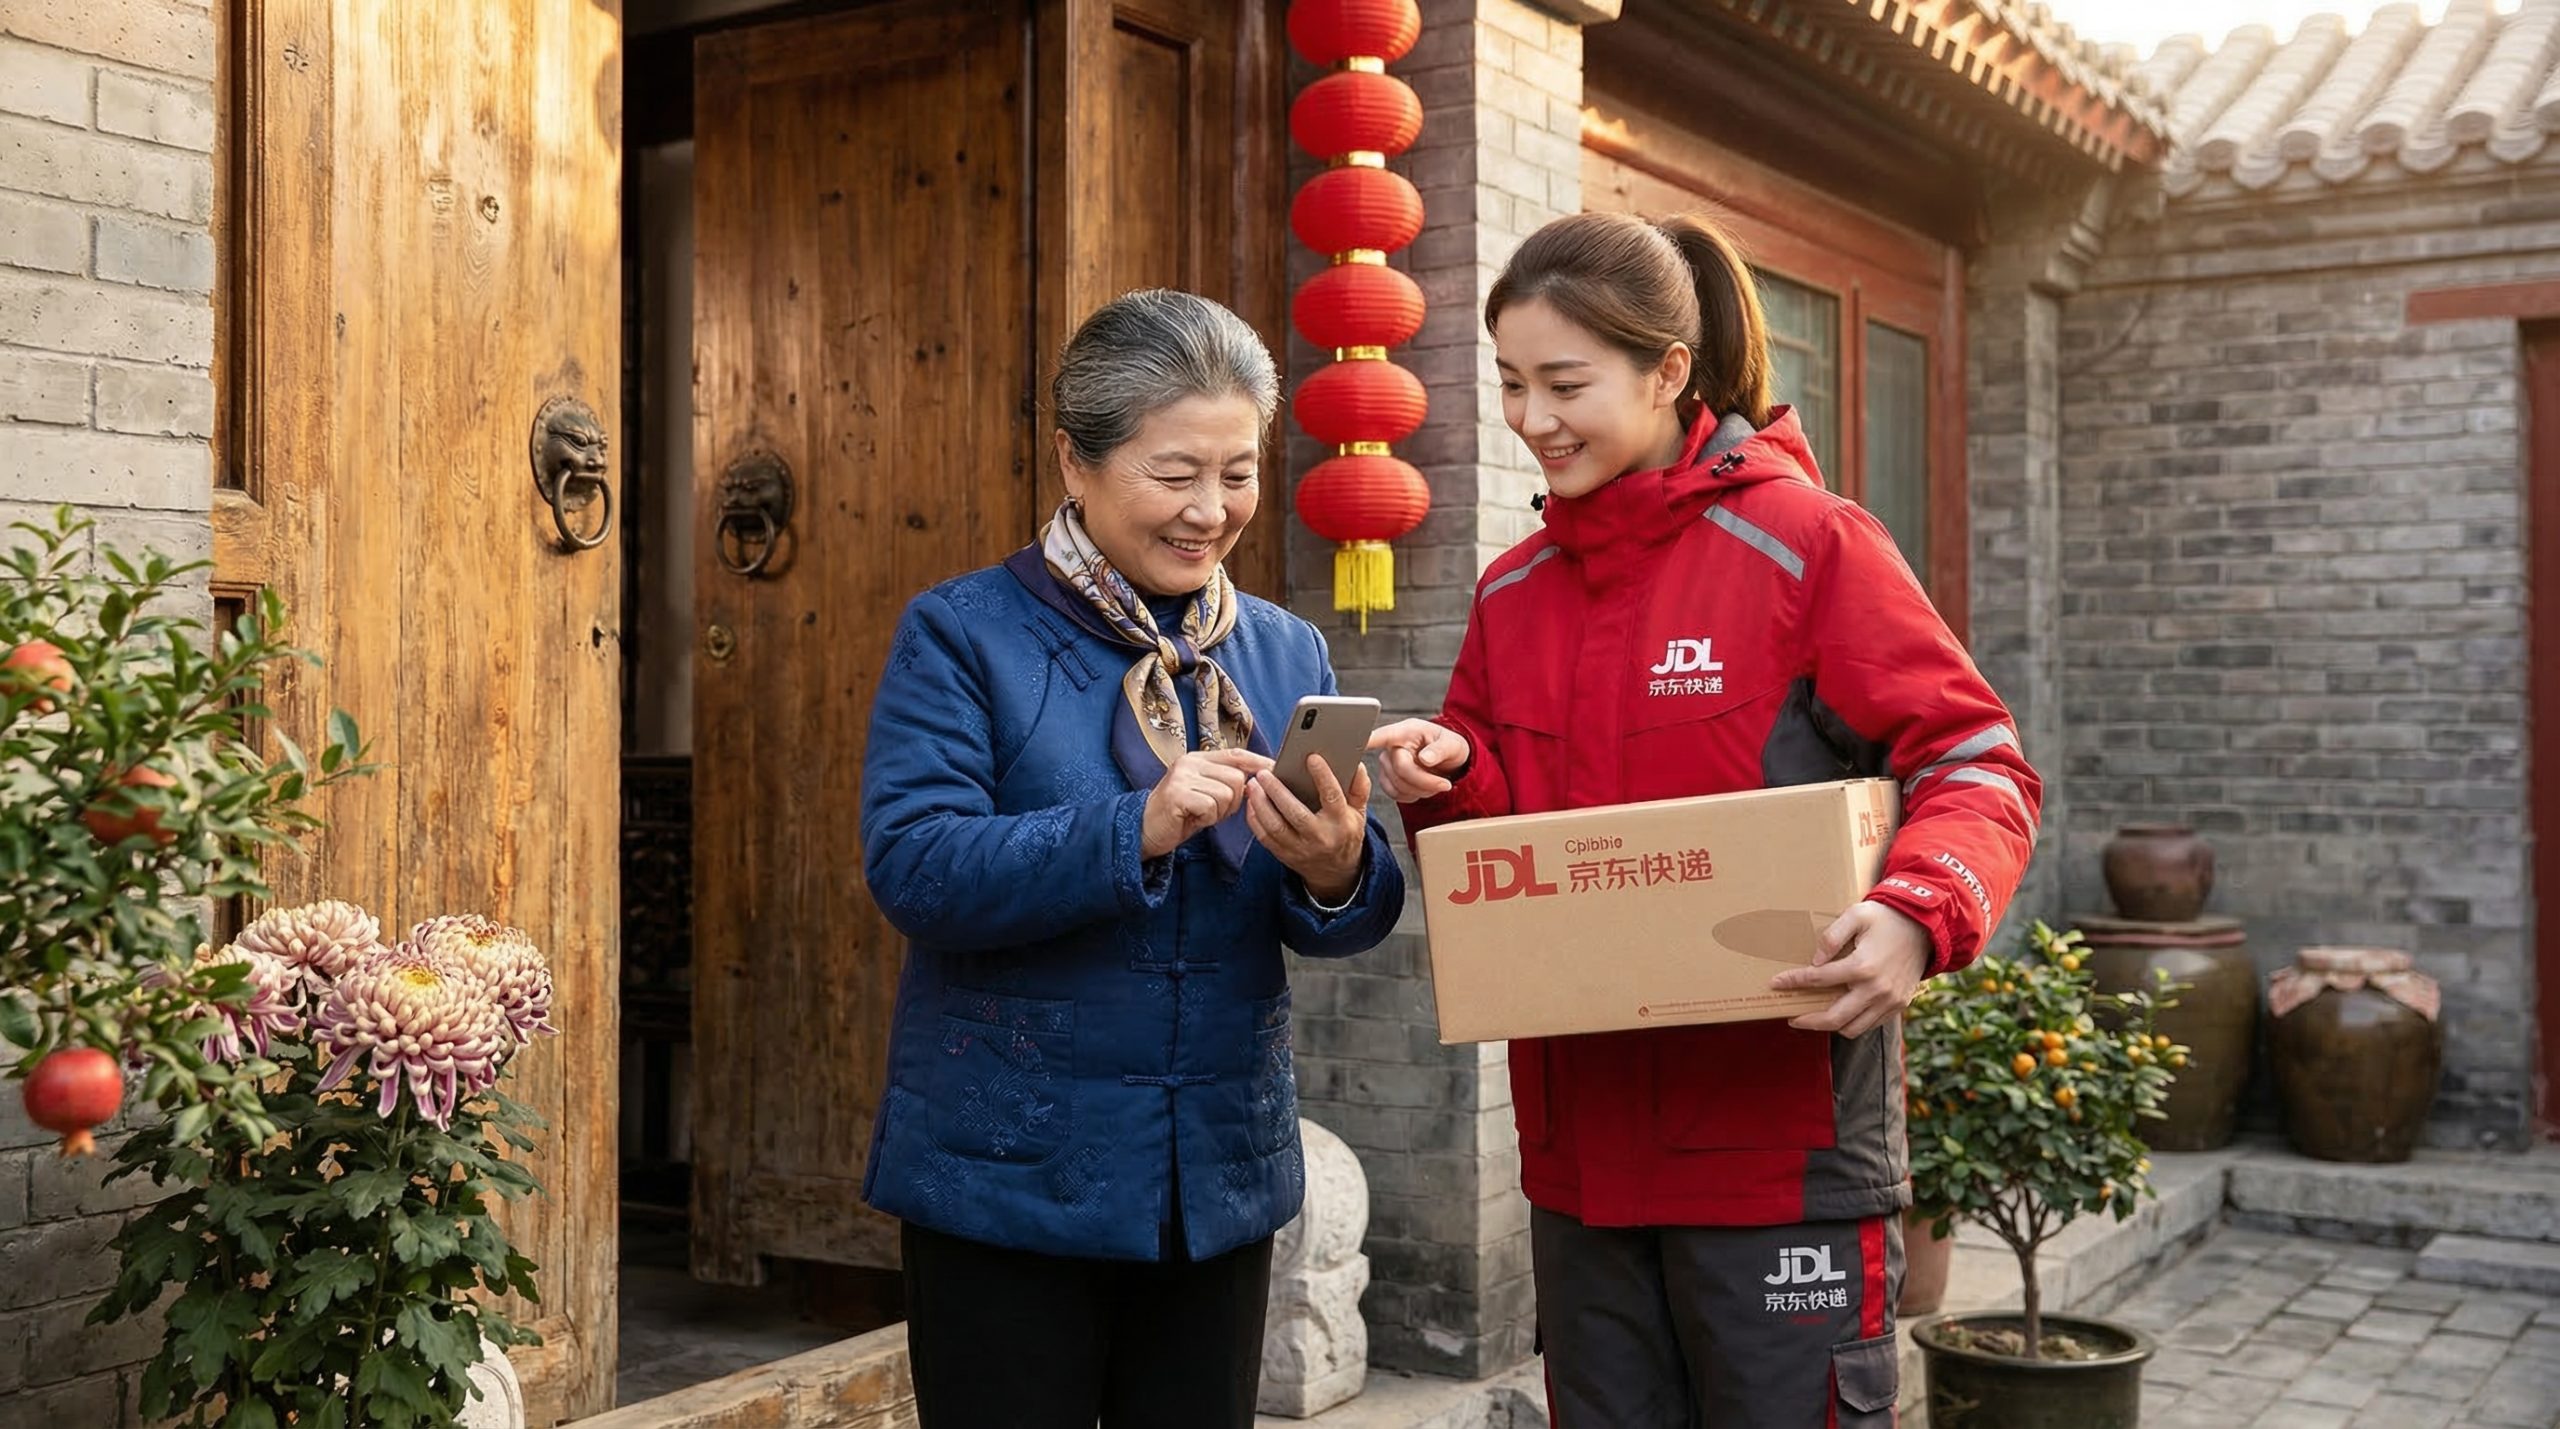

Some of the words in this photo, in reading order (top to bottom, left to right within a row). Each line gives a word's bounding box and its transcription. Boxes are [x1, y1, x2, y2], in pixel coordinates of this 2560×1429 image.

[1650, 638, 1723, 675] JDL
[1648, 676, 1723, 697] 京东快递
[1448, 844, 1559, 905] JDL
[1566, 848, 1714, 894] 京东快递
[1764, 1245, 1846, 1285] JDL
[1764, 1287, 1849, 1312] 京东快递
